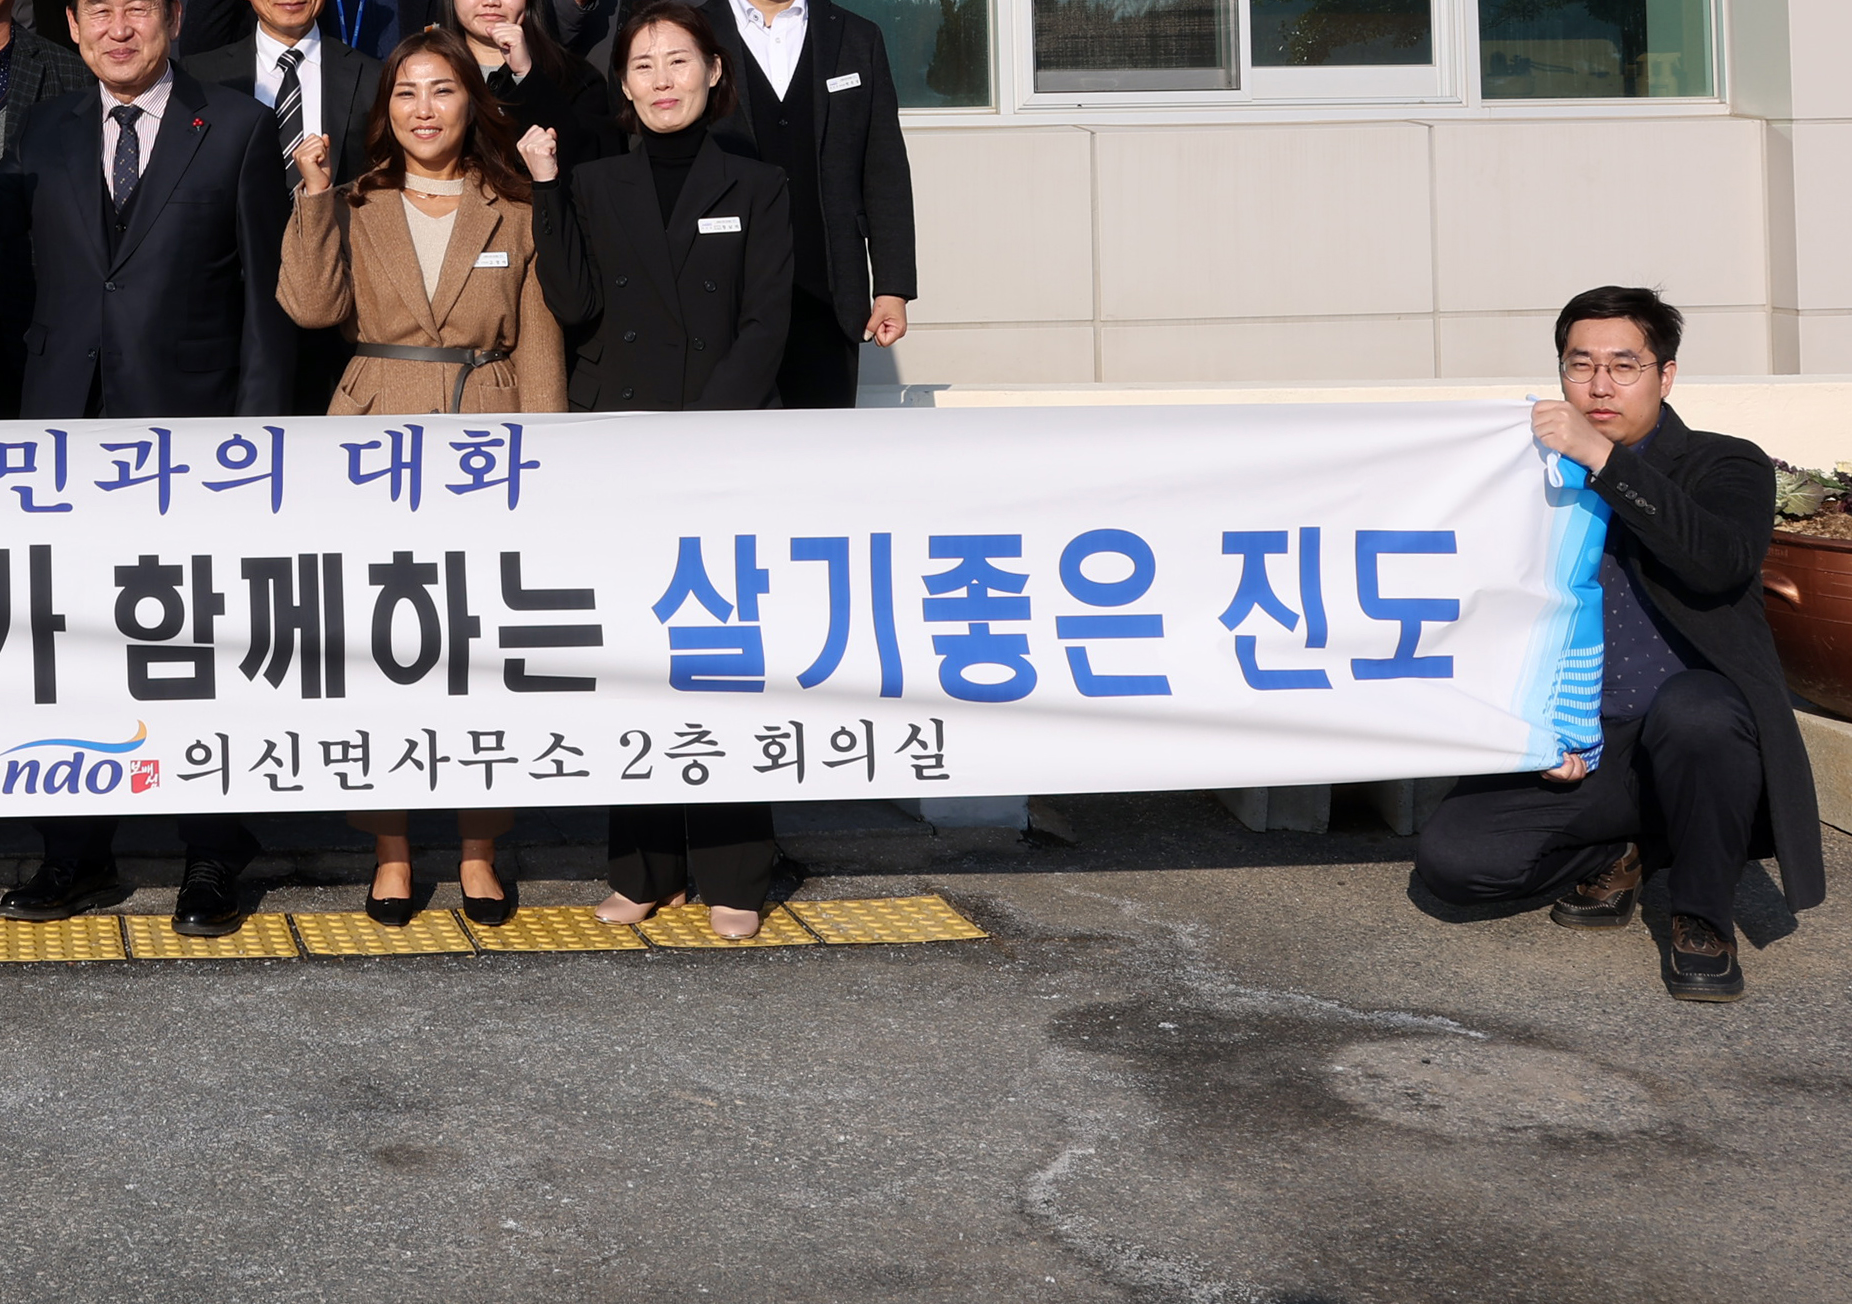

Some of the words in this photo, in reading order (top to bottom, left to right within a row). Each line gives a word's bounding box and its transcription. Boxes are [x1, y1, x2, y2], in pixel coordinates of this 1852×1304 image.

[343, 424, 539, 511] 대화
[114, 551, 604, 701] 함께하는
[652, 528, 1172, 703] 살기좋은
[1218, 526, 1461, 691] 진도
[176, 728, 590, 795] 의신면사무소
[619, 722, 726, 786] 2층
[753, 717, 950, 784] 회의실
